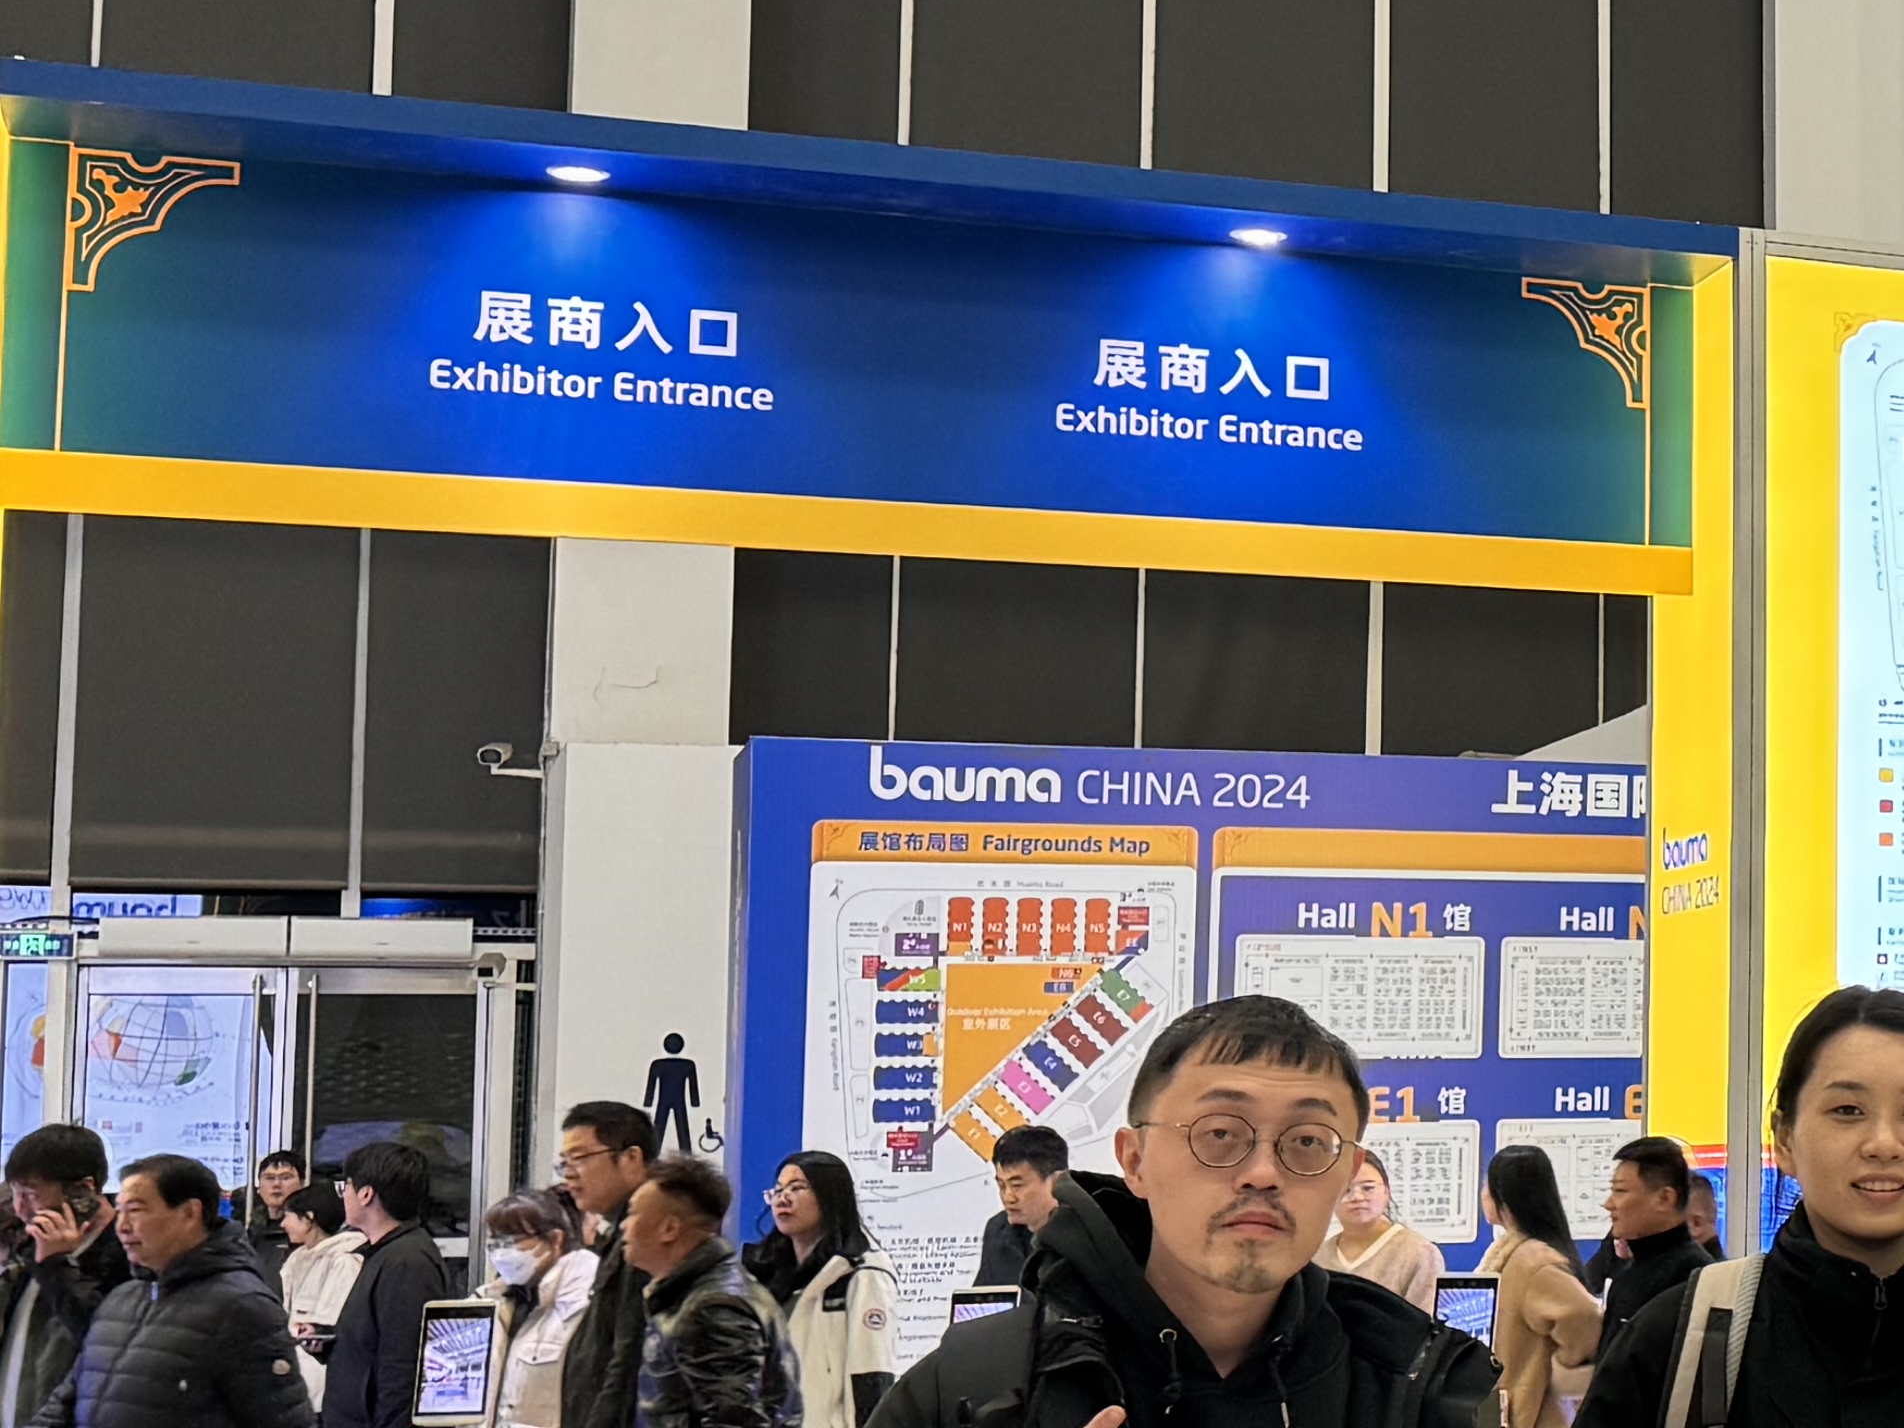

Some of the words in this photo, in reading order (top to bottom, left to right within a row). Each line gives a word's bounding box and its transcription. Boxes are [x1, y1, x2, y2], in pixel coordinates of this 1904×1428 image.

[472, 289, 739, 358] 展商入口
[1093, 338, 1330, 401] 展商入口
[429, 358, 603, 400] Exhibitor
[613, 371, 775, 412] Entrance
[1055, 402, 1210, 441] Exhibitor
[1218, 414, 1364, 452] Entrance
[869, 743, 1062, 803] bauma
[1076, 769, 1202, 806] CHINA
[1212, 772, 1311, 809] 2024
[858, 831, 970, 852] 展馆布局图
[982, 834, 1103, 856] Fairgrounds
[1109, 837, 1151, 857] Map
[1662, 826, 1708, 870] bauma
[953, 922, 968, 932] N1
[987, 922, 1003, 932] N2
[1022, 923, 1037, 933] N3
[1055, 923, 1072, 933] N4
[1090, 923, 1105, 933] N5
[1297, 901, 1356, 929] Hall
[1369, 901, 1433, 937] N1
[1443, 902, 1472, 932] 馆
[1559, 905, 1614, 932] Hall
[1628, 905, 1646, 939] N
[907, 1007, 925, 1017] W4
[907, 1040, 923, 1050] W3
[905, 1073, 923, 1083] W2
[904, 1106, 920, 1115] W1
[1437, 1087, 1467, 1115] 馆
[1555, 1086, 1610, 1113] Hall
